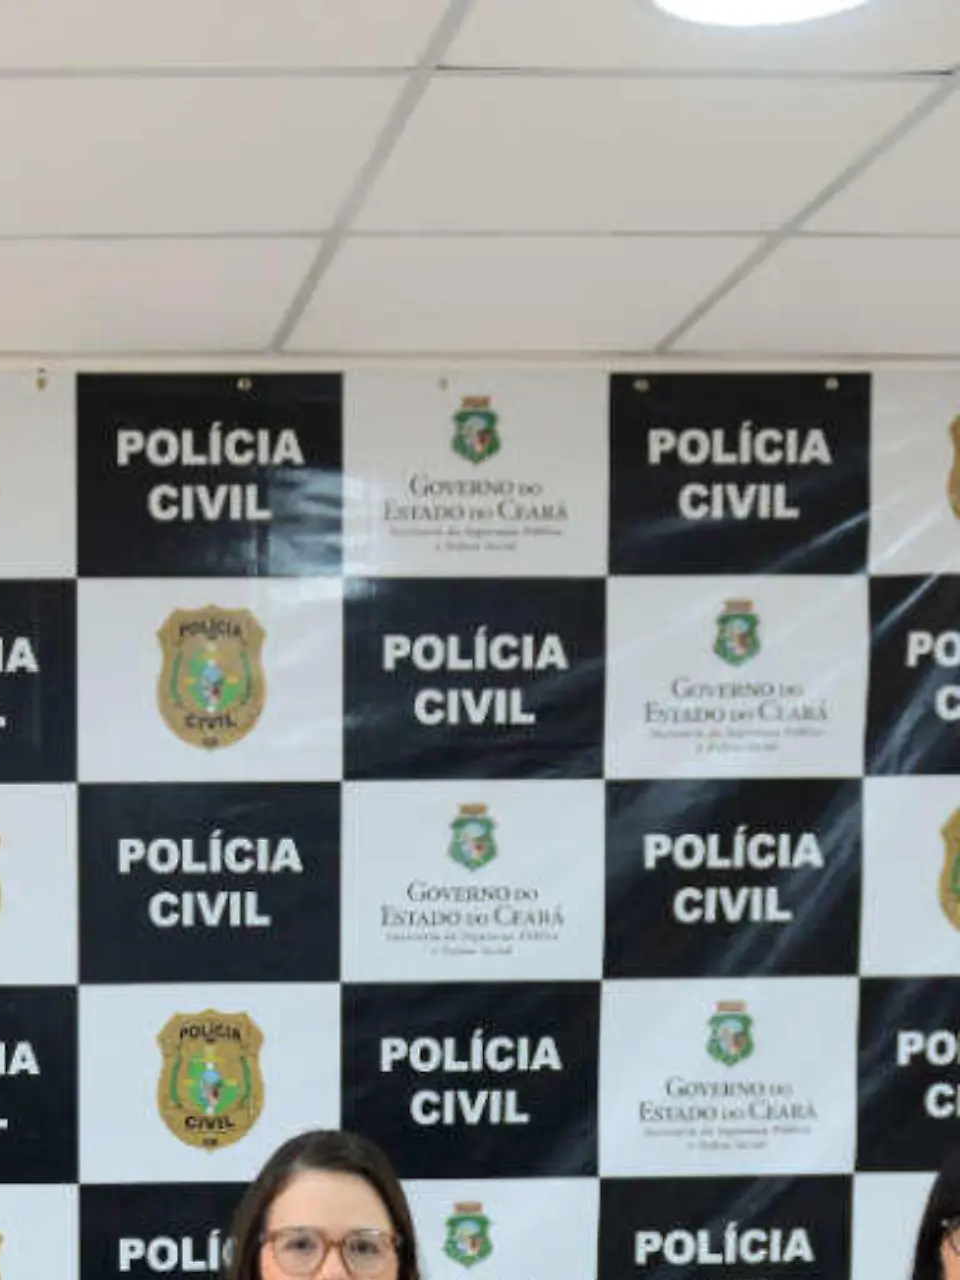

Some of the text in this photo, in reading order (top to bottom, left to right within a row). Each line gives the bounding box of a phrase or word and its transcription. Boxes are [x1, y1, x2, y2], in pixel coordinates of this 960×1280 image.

[118, 422, 304, 465] POLÍCIA
[649, 422, 831, 464] POLÍCIA
[149, 485, 273, 520] CIVIL
[679, 484, 799, 520] CIVIL
[384, 627, 567, 670] POLÍCIA
[415, 689, 535, 724] CIVIL
[119, 829, 302, 873] POLÍCIA
[644, 826, 824, 868] POLÍCIA
[150, 892, 270, 926] CIVIL
[674, 887, 792, 922] CIVIL
[381, 1029, 561, 1072] POLÍCIA
[411, 1091, 528, 1124] CIVIL
[636, 1222, 813, 1264] POLÍCIA
